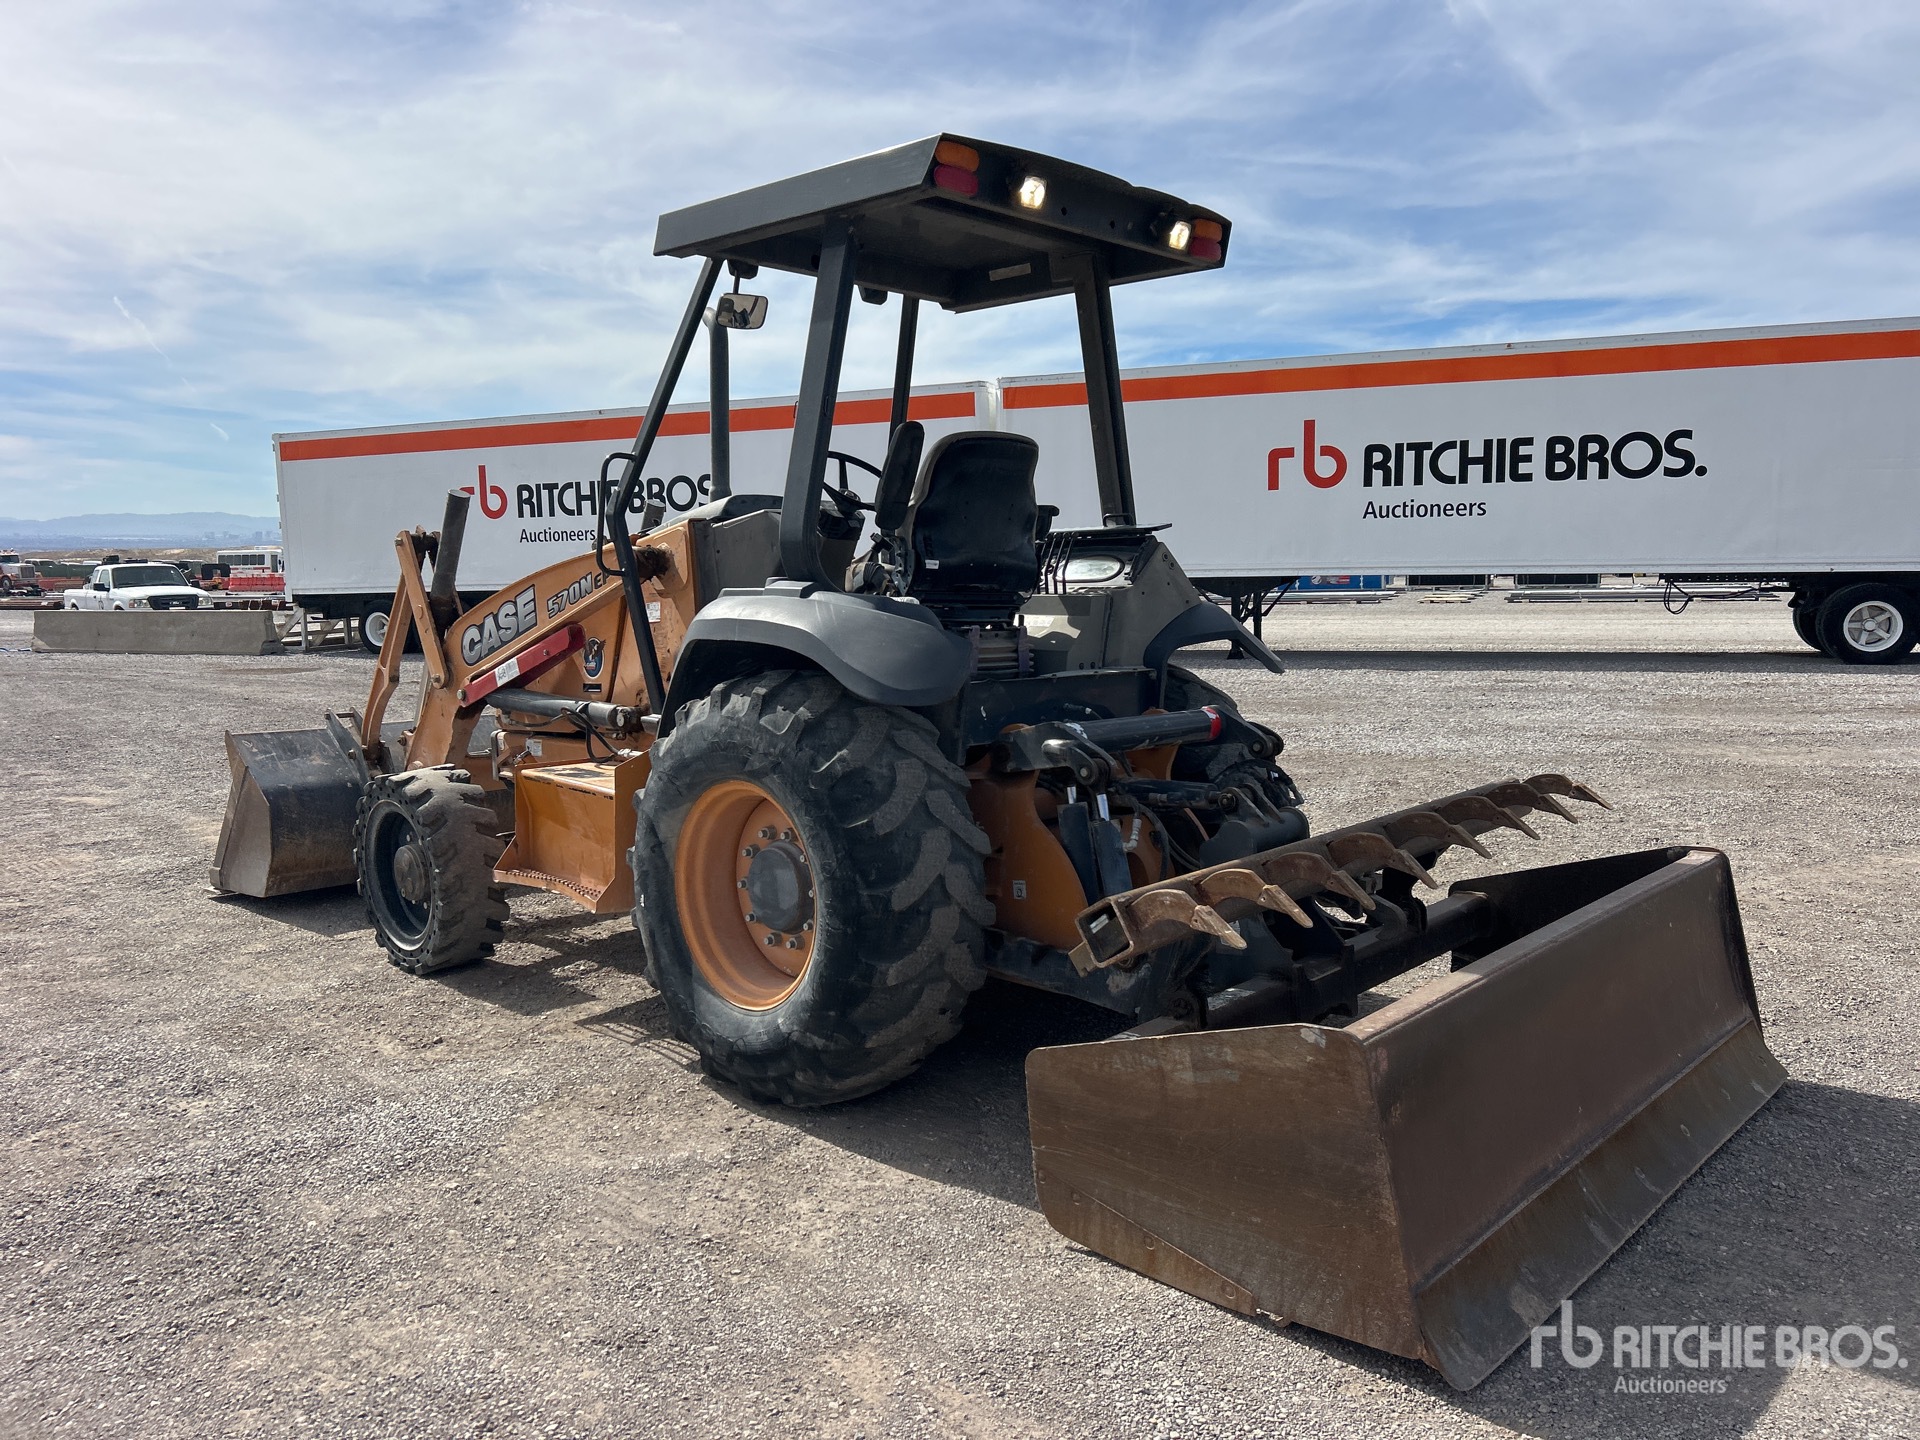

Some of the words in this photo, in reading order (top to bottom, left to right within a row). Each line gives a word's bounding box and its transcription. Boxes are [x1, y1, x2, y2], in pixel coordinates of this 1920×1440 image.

[1267, 419, 1347, 491] rb
[1363, 436, 1534, 488] RITCHIE
[1545, 429, 1708, 480] BROS.
[1362, 499, 1487, 520] Auctioneers
[519, 527, 596, 544] Auctioneers
[547, 571, 594, 619] 570N
[461, 584, 537, 666] CASE
